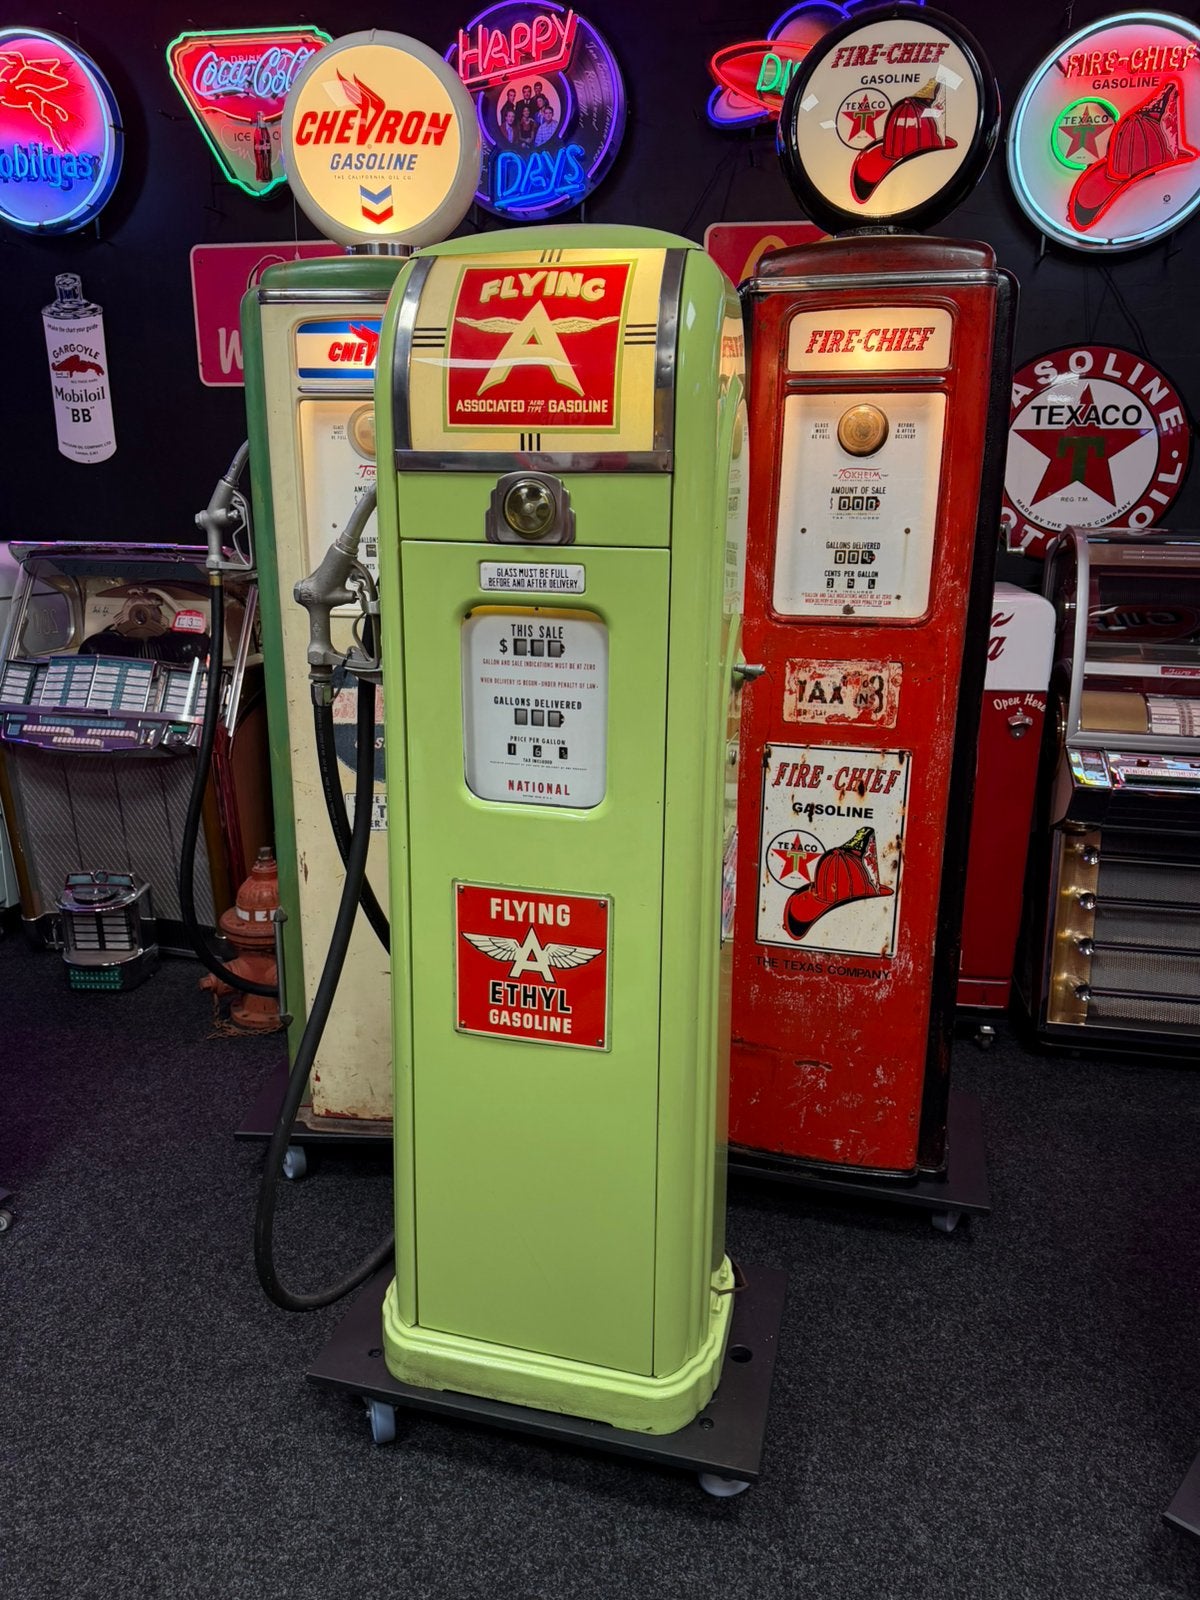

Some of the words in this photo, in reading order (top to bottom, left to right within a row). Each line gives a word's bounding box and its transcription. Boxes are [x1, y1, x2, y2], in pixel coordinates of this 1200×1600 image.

[458, 9, 577, 84] HAPPY
[831, 43, 950, 69] FIRE-CHIEF
[1066, 44, 1198, 78] FIRE-CHIEF
[193, 46, 316, 97] Coca-Col
[860, 73, 921, 85] GASOLINE
[1092, 76, 1160, 90] GASOLINE
[845, 100, 886, 111] TEXACO
[295, 88, 453, 146] CHEVRON
[1063, 115, 1109, 125] TEXACO
[234, 132, 251, 142] ICE
[0, 142, 93, 188] obilgas
[330, 153, 418, 171] GASOLINE
[495, 144, 585, 206] DAYS
[479, 271, 607, 304] FLYING
[476, 300, 586, 397] A
[805, 327, 936, 354] FIRE-CHIEF
[52, 343, 100, 360] GARGOYLE
[54, 385, 106, 403] Mobiloil
[1012, 350, 1184, 432] ASOLINE
[456, 399, 525, 414] ASSOCIATED
[548, 399, 608, 414] GASOLINE
[1031, 405, 1142, 425] TEXACO
[838, 467, 882, 480] TOKHEIM
[831, 486, 858, 494] AMOUNT
[861, 486, 869, 494] OF
[871, 487, 886, 495] SALE
[1128, 463, 1183, 529] OIL
[1016, 499, 1032, 517] MADE
[1034, 516, 1044, 524] BY
[1046, 520, 1062, 528] THE
[1094, 500, 1131, 525] COMPANY
[826, 541, 851, 549] GALLONS
[852, 541, 881, 550] DELIVERED
[496, 568, 517, 577] GLASS
[519, 568, 538, 578] MUST
[539, 569, 548, 578] BE
[551, 569, 569, 578] FULL
[488, 578, 511, 587] BEFORE
[512, 578, 525, 587] AND
[527, 579, 547, 588] AFTER
[549, 579, 578, 589] DELIVERY
[511, 624, 533, 637] THIS
[539, 625, 564, 639] SALE
[499, 638, 508, 654] $
[511, 659, 523, 667] SALE
[524, 660, 554, 668] INDICATIONS
[494, 677, 515, 685] DELIVERY
[494, 696, 531, 707] GALLONS
[535, 698, 582, 710] DELIVERED
[993, 696, 1021, 711] Open
[1024, 693, 1047, 712] Here
[542, 738, 566, 746] GALLON
[508, 780, 570, 796] NATIONAL
[792, 802, 874, 819] GASOLINE
[777, 841, 818, 852] TEXACO
[490, 897, 571, 927] FLYING
[508, 924, 557, 984] A
[756, 956, 778, 968] THE
[784, 960, 823, 973] TEXAS
[827, 965, 890, 980] COMPANY
[489, 979, 573, 1015] ETHYL
[489, 1008, 572, 1034] GASOLINE
